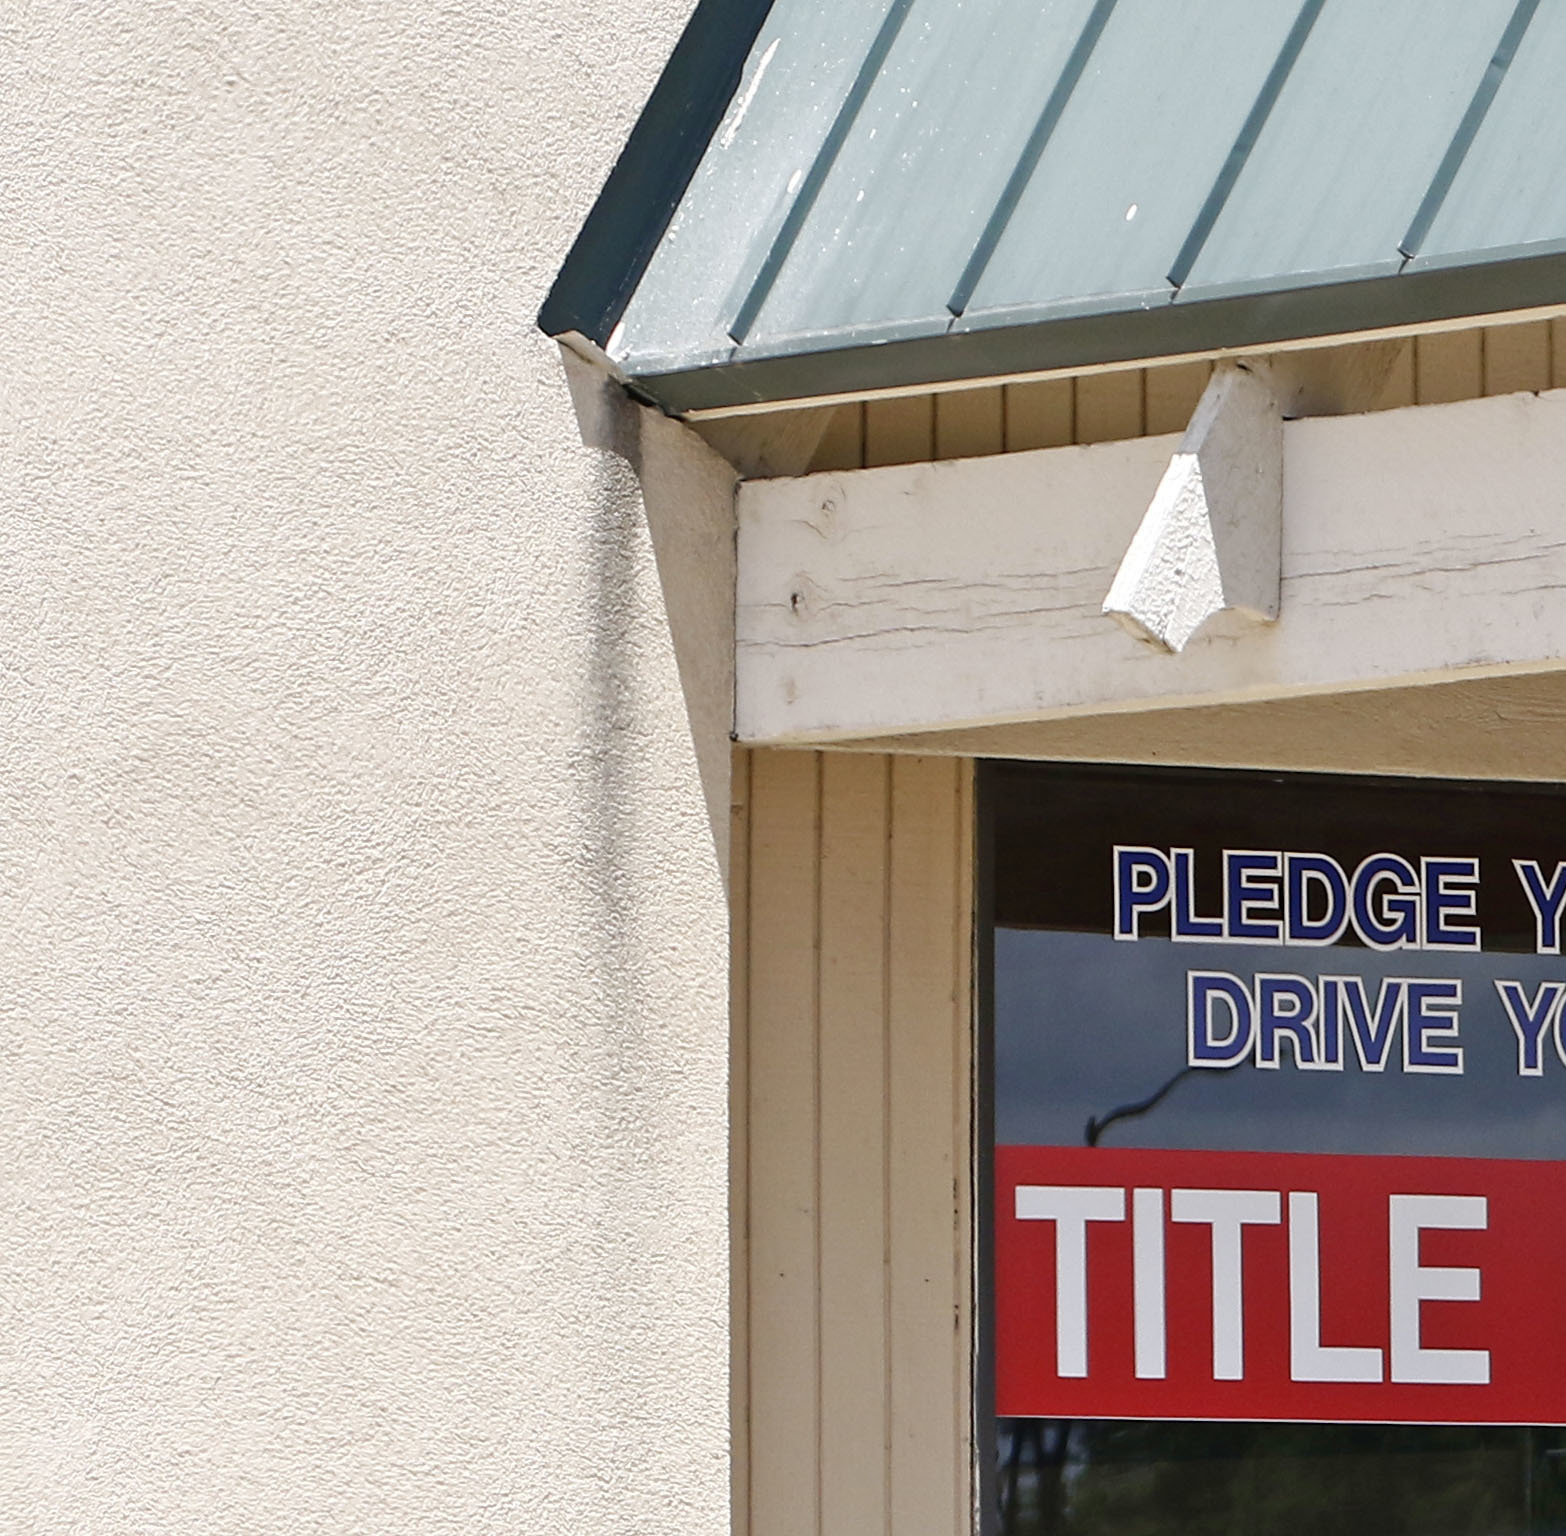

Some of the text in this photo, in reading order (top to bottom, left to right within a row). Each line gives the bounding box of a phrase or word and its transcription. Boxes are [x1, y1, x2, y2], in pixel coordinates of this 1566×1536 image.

[1112, 845, 1482, 952] PLEDGE
[1187, 970, 1464, 1075] DRIVE
[1014, 1185, 1491, 1385] TITLE
